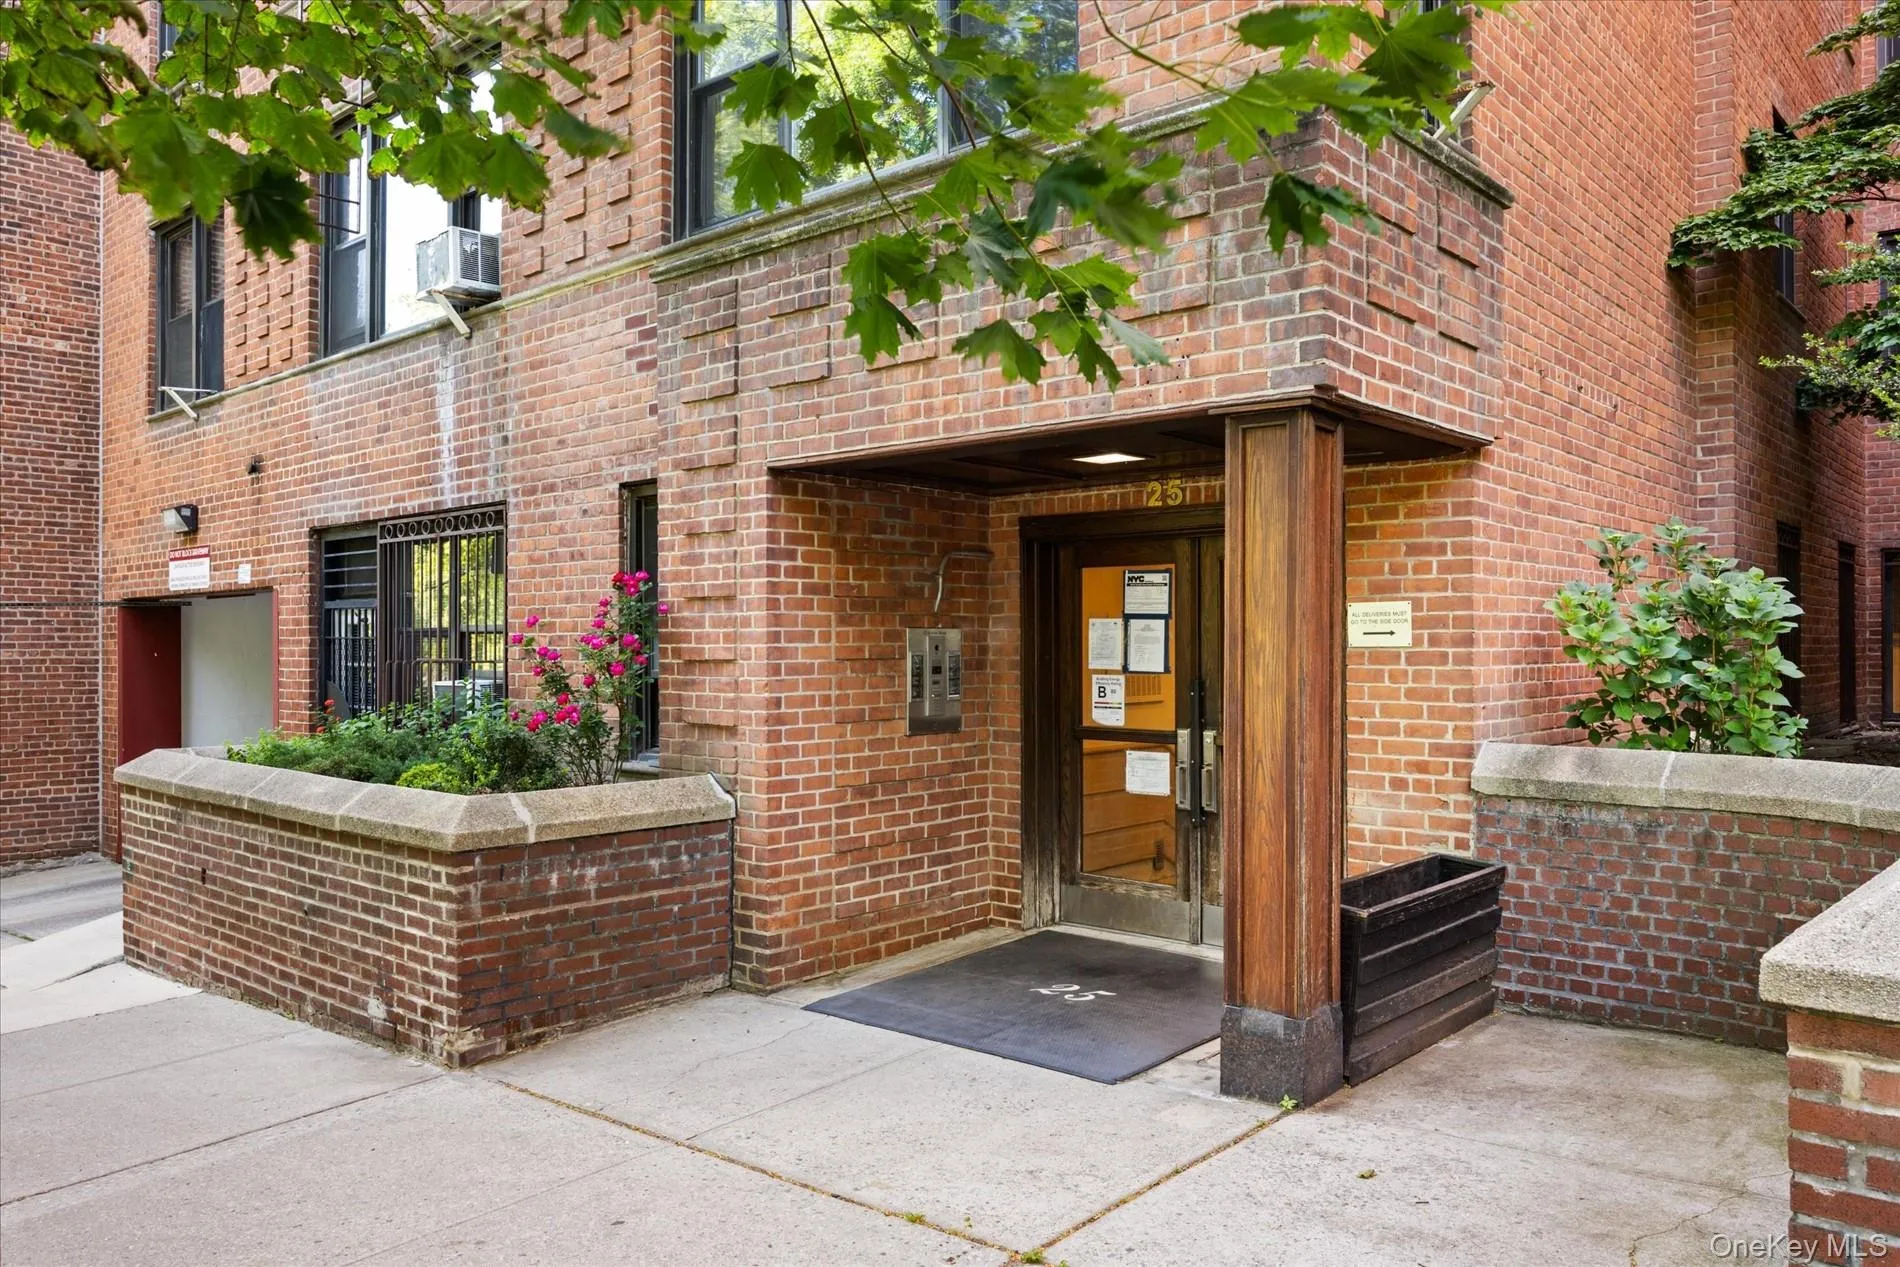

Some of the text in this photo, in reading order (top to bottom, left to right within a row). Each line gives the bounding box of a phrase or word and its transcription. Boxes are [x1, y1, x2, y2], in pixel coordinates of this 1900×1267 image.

[1147, 480, 1183, 506] 25
[1127, 575, 1145, 583] NYC
[1098, 686, 1107, 698] B
[1028, 983, 1117, 1001] 25
